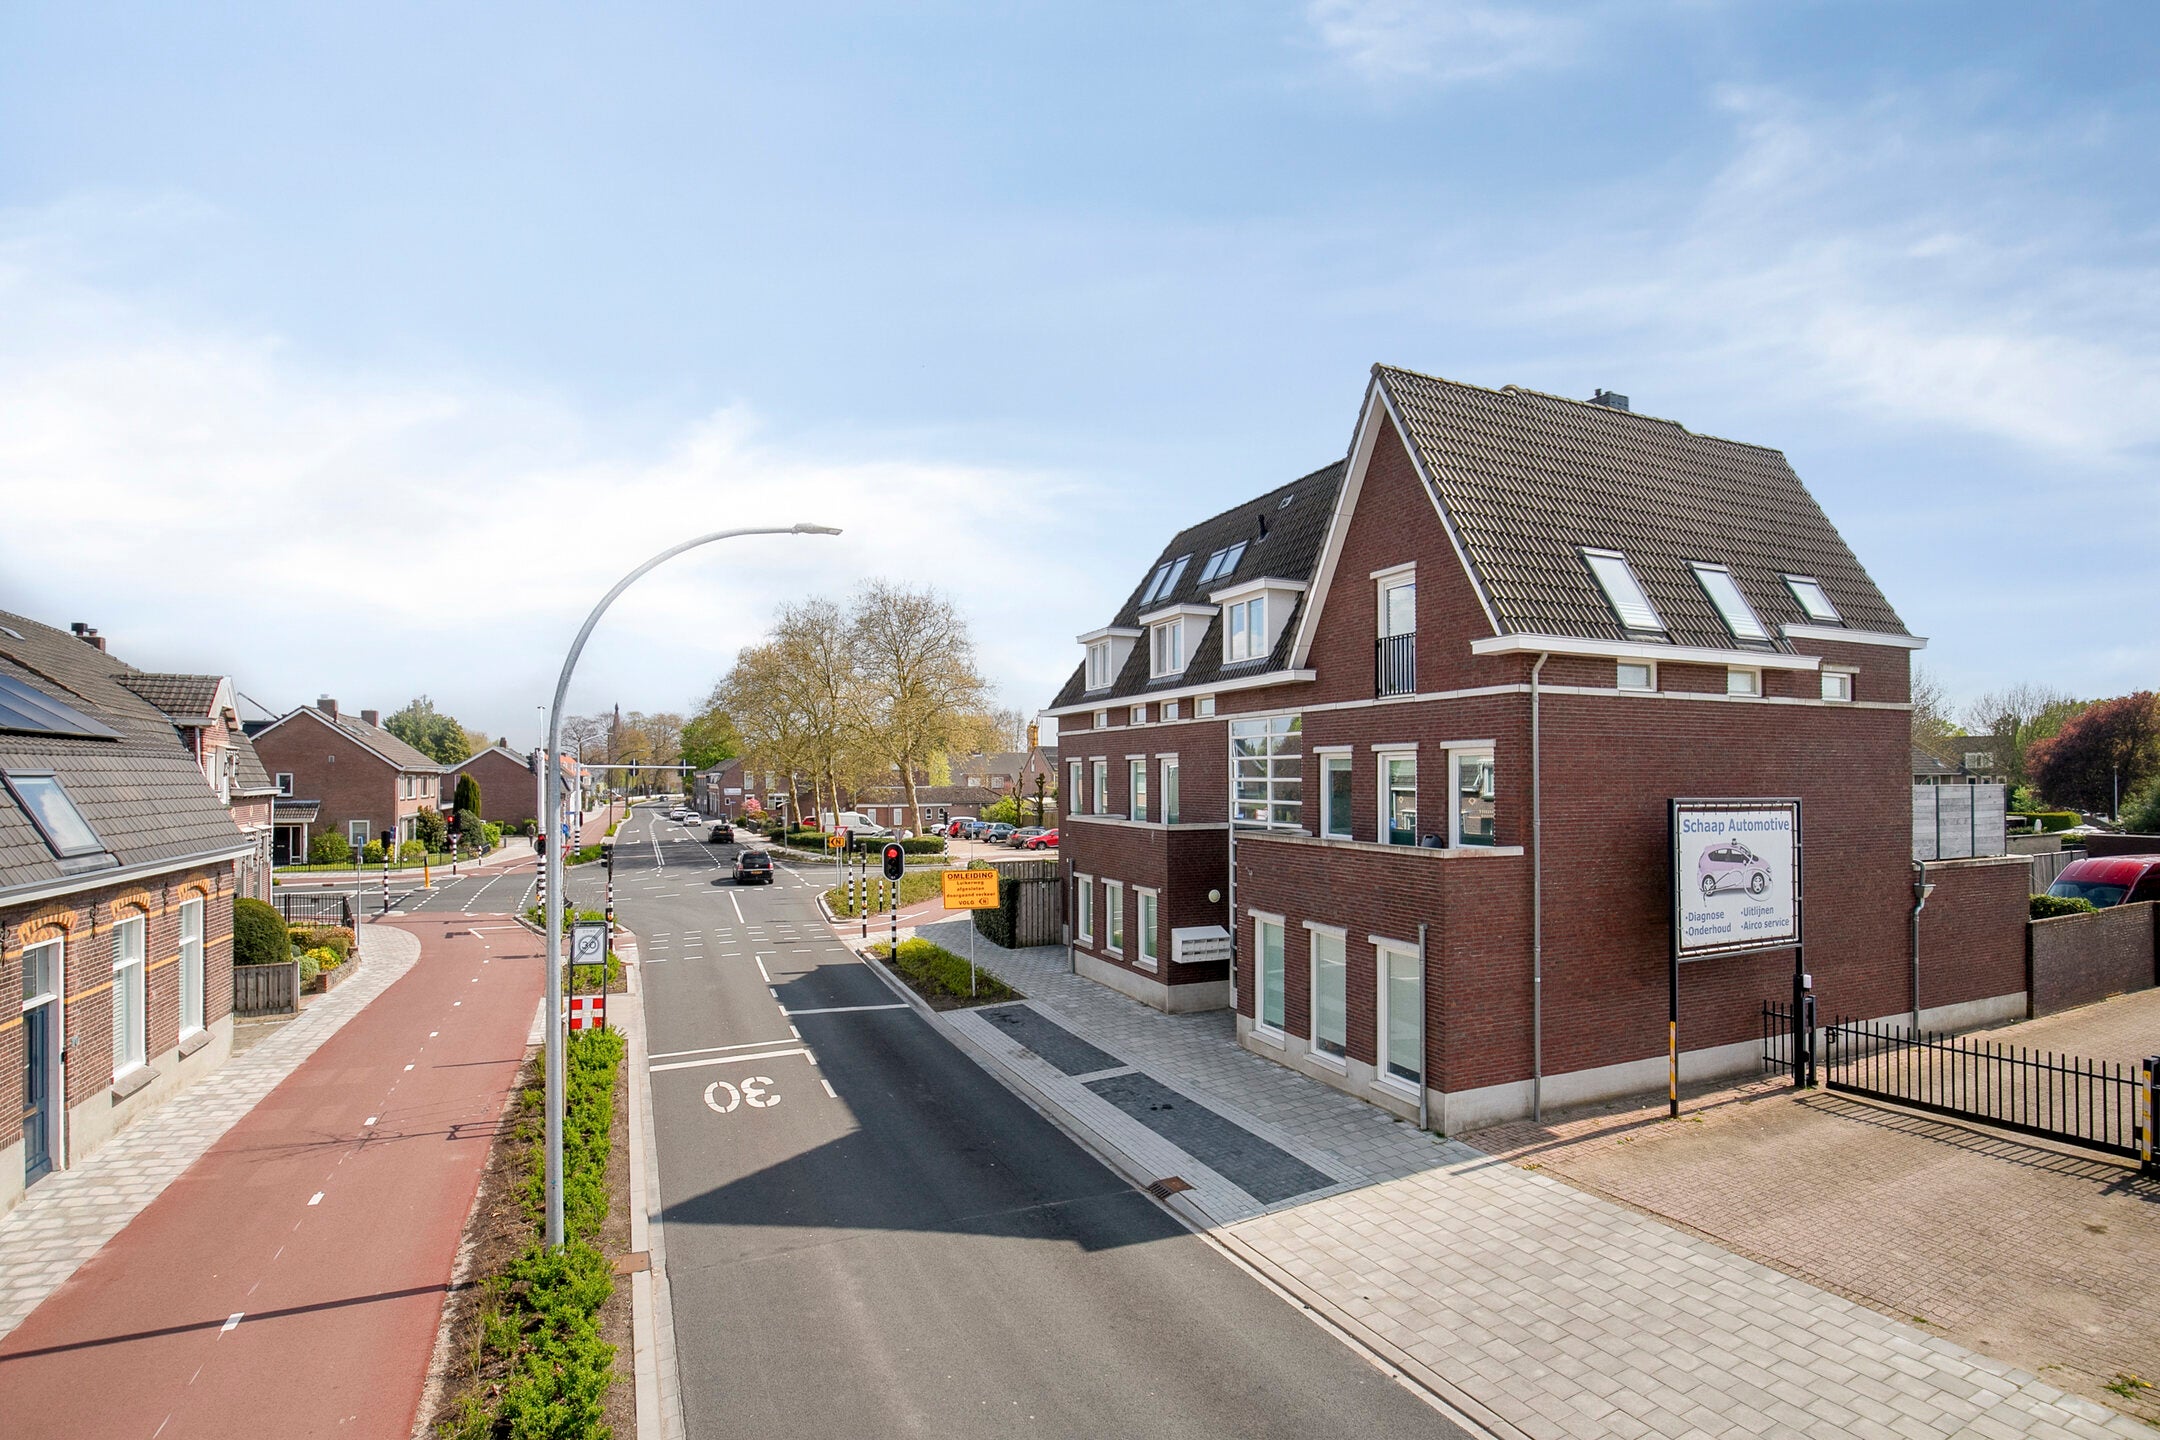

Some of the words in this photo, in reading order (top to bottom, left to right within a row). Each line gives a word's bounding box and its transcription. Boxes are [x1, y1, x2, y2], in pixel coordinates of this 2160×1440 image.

[1683, 819, 1725, 835] Schaap
[1728, 817, 1790, 832] Automotive
[1688, 911, 1725, 922] Diagnose
[1742, 906, 1774, 917] Uitlijnen
[1687, 923, 1732, 936] Onderhoud
[1743, 920, 1763, 930] Airco
[1764, 918, 1790, 927] service
[581, 940, 597, 950] 30
[704, 1076, 781, 1114] 30
